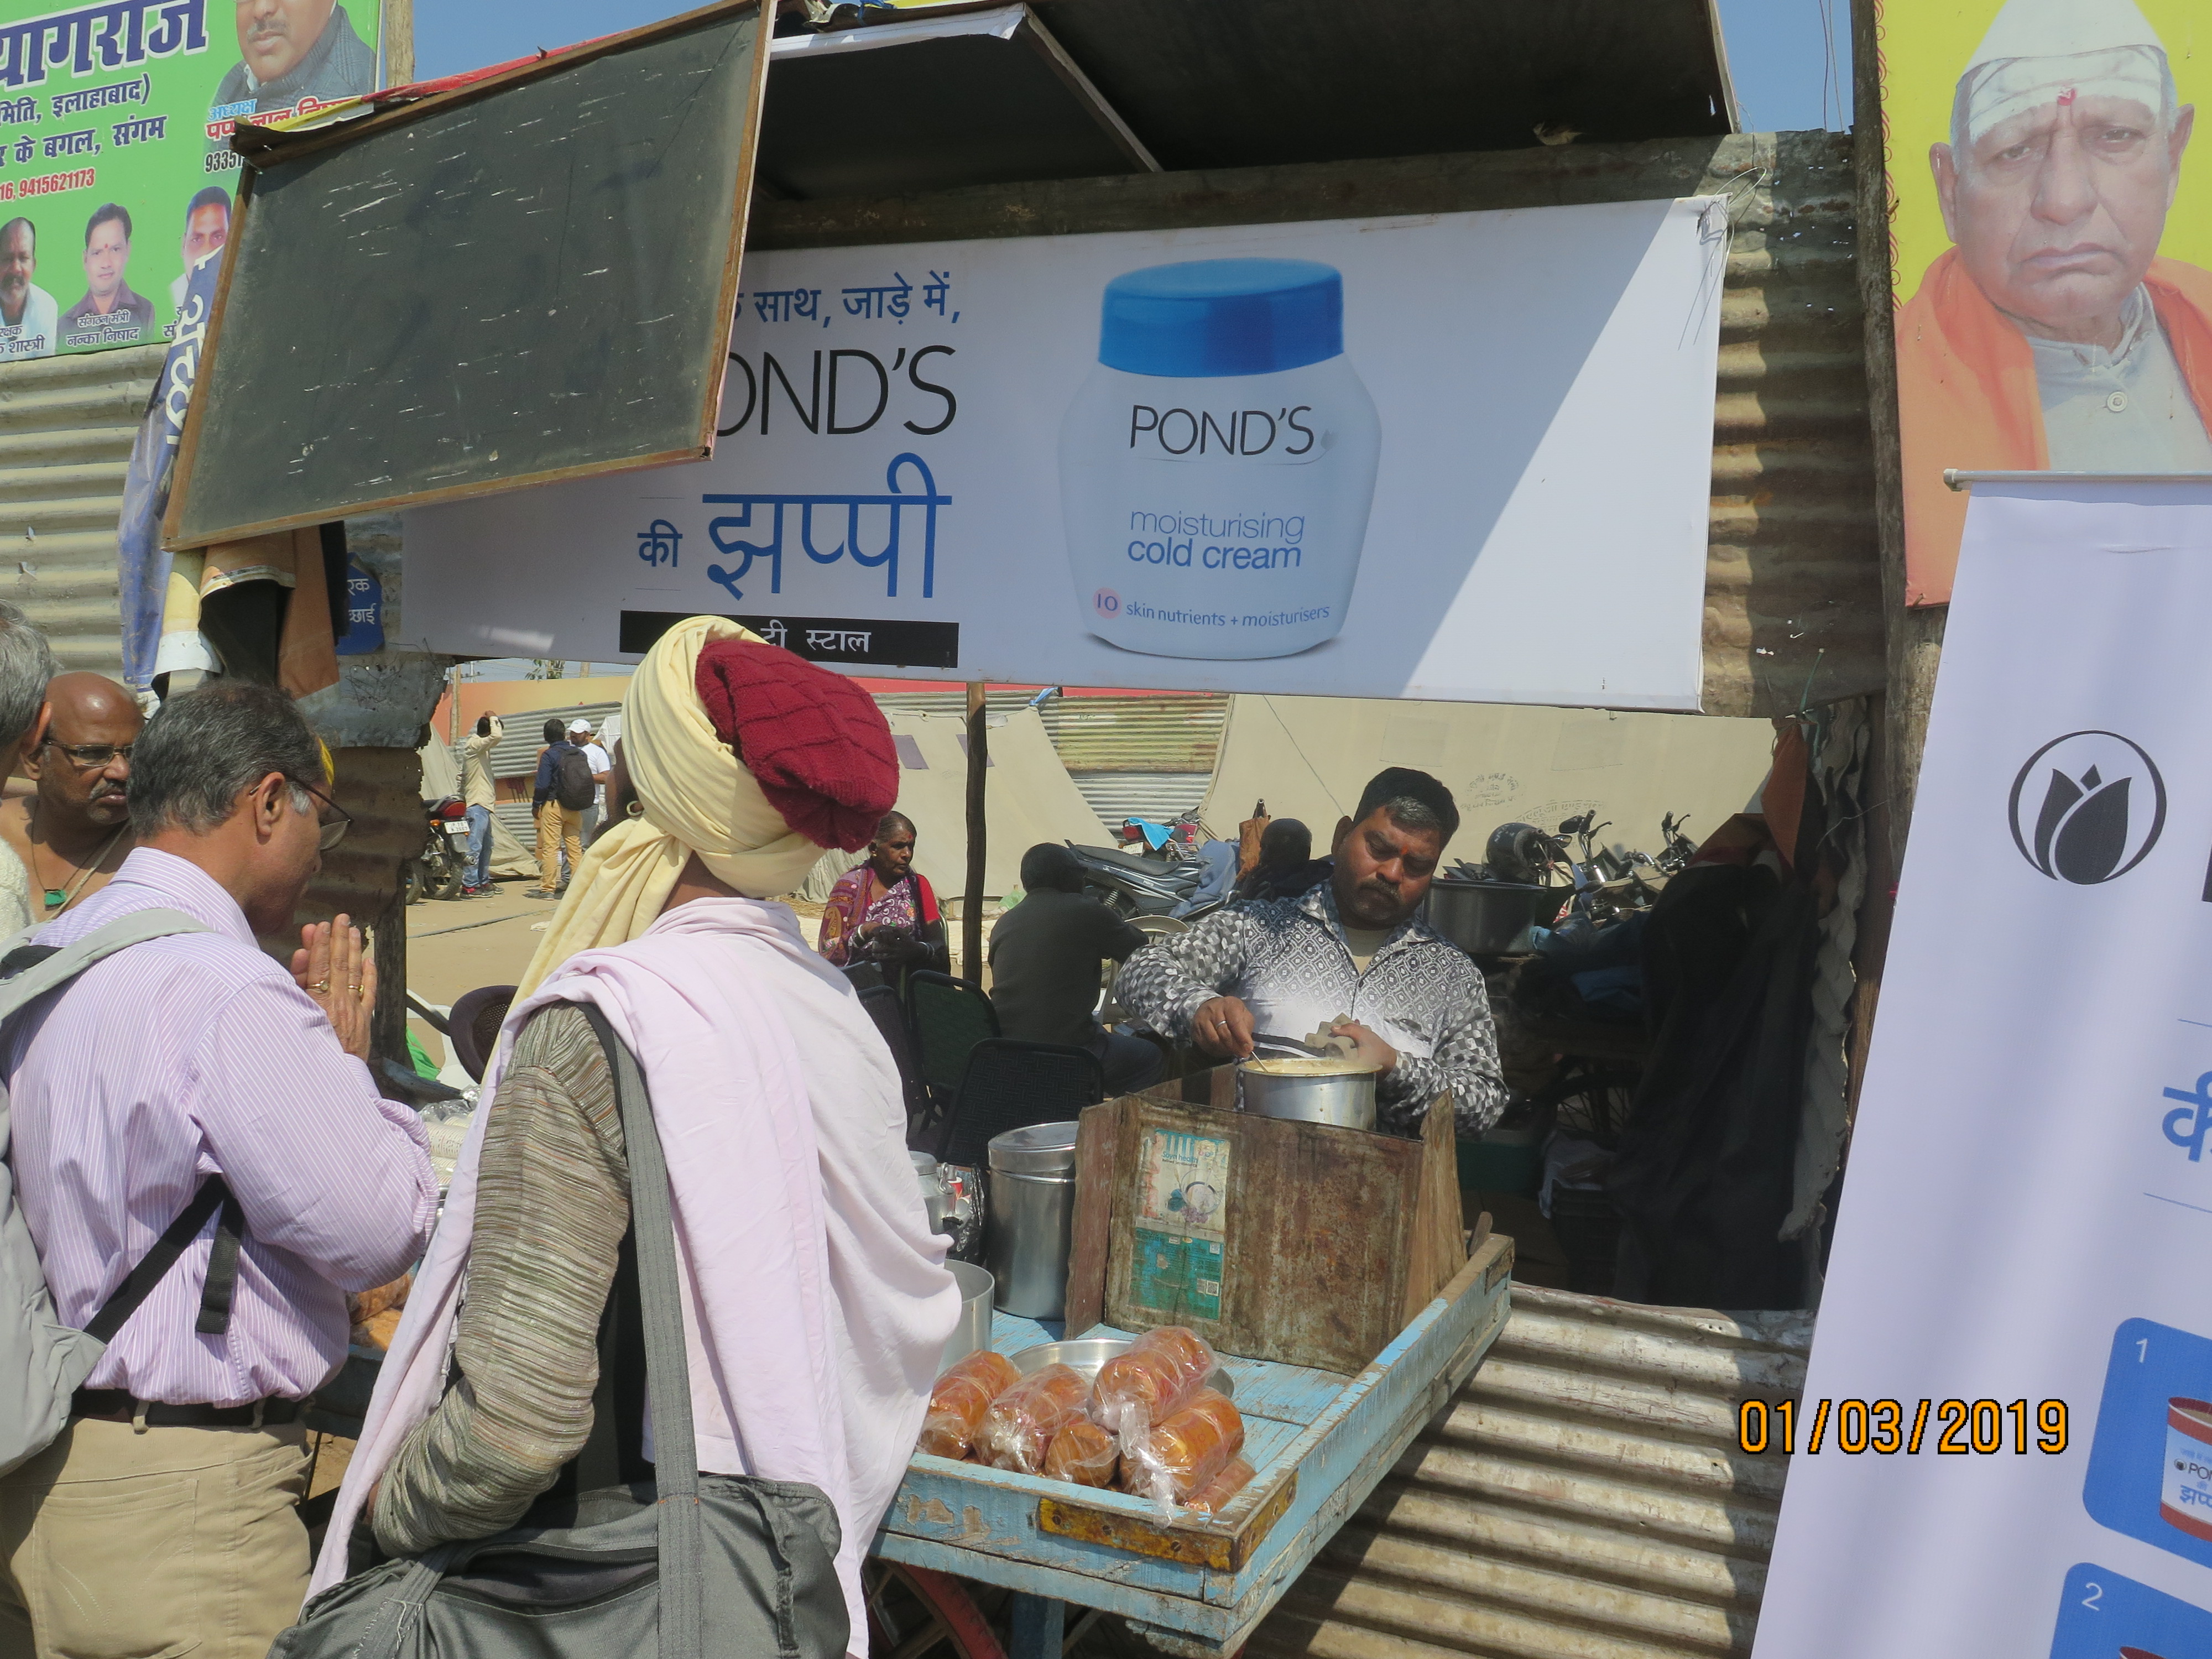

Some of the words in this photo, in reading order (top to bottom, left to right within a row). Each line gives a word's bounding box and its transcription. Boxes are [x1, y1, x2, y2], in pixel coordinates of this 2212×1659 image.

[51, 73, 150, 118] इलाहाबाद)
[207, 98, 258, 121] अध्यक्ष
[14, 135, 36, 163] के
[43, 129, 101, 157] बगल,
[112, 115, 167, 146] संगम
[19, 168, 95, 197] 9415621173
[753, 288, 831, 328] साथ,
[842, 272, 912, 325] जाड़े
[924, 269, 960, 324] में,
[9, 334, 45, 353] शास्त्री
[103, 327, 139, 342] निषाद
[1129, 404, 1314, 456] POND'S
[637, 519, 683, 567] की
[702, 452, 952, 601] झप्पी
[1130, 510, 1305, 544] moisturising
[1128, 536, 1193, 567] cold
[1202, 546, 1301, 569] cream
[1126, 601, 1155, 619] skin
[1157, 609, 1226, 627] nutrients
[1242, 606, 1330, 627] moisturisers
[806, 629, 872, 653] स्टाल
[2135, 1338, 2148, 1363] 1
[2081, 1582, 2103, 1611] 2
